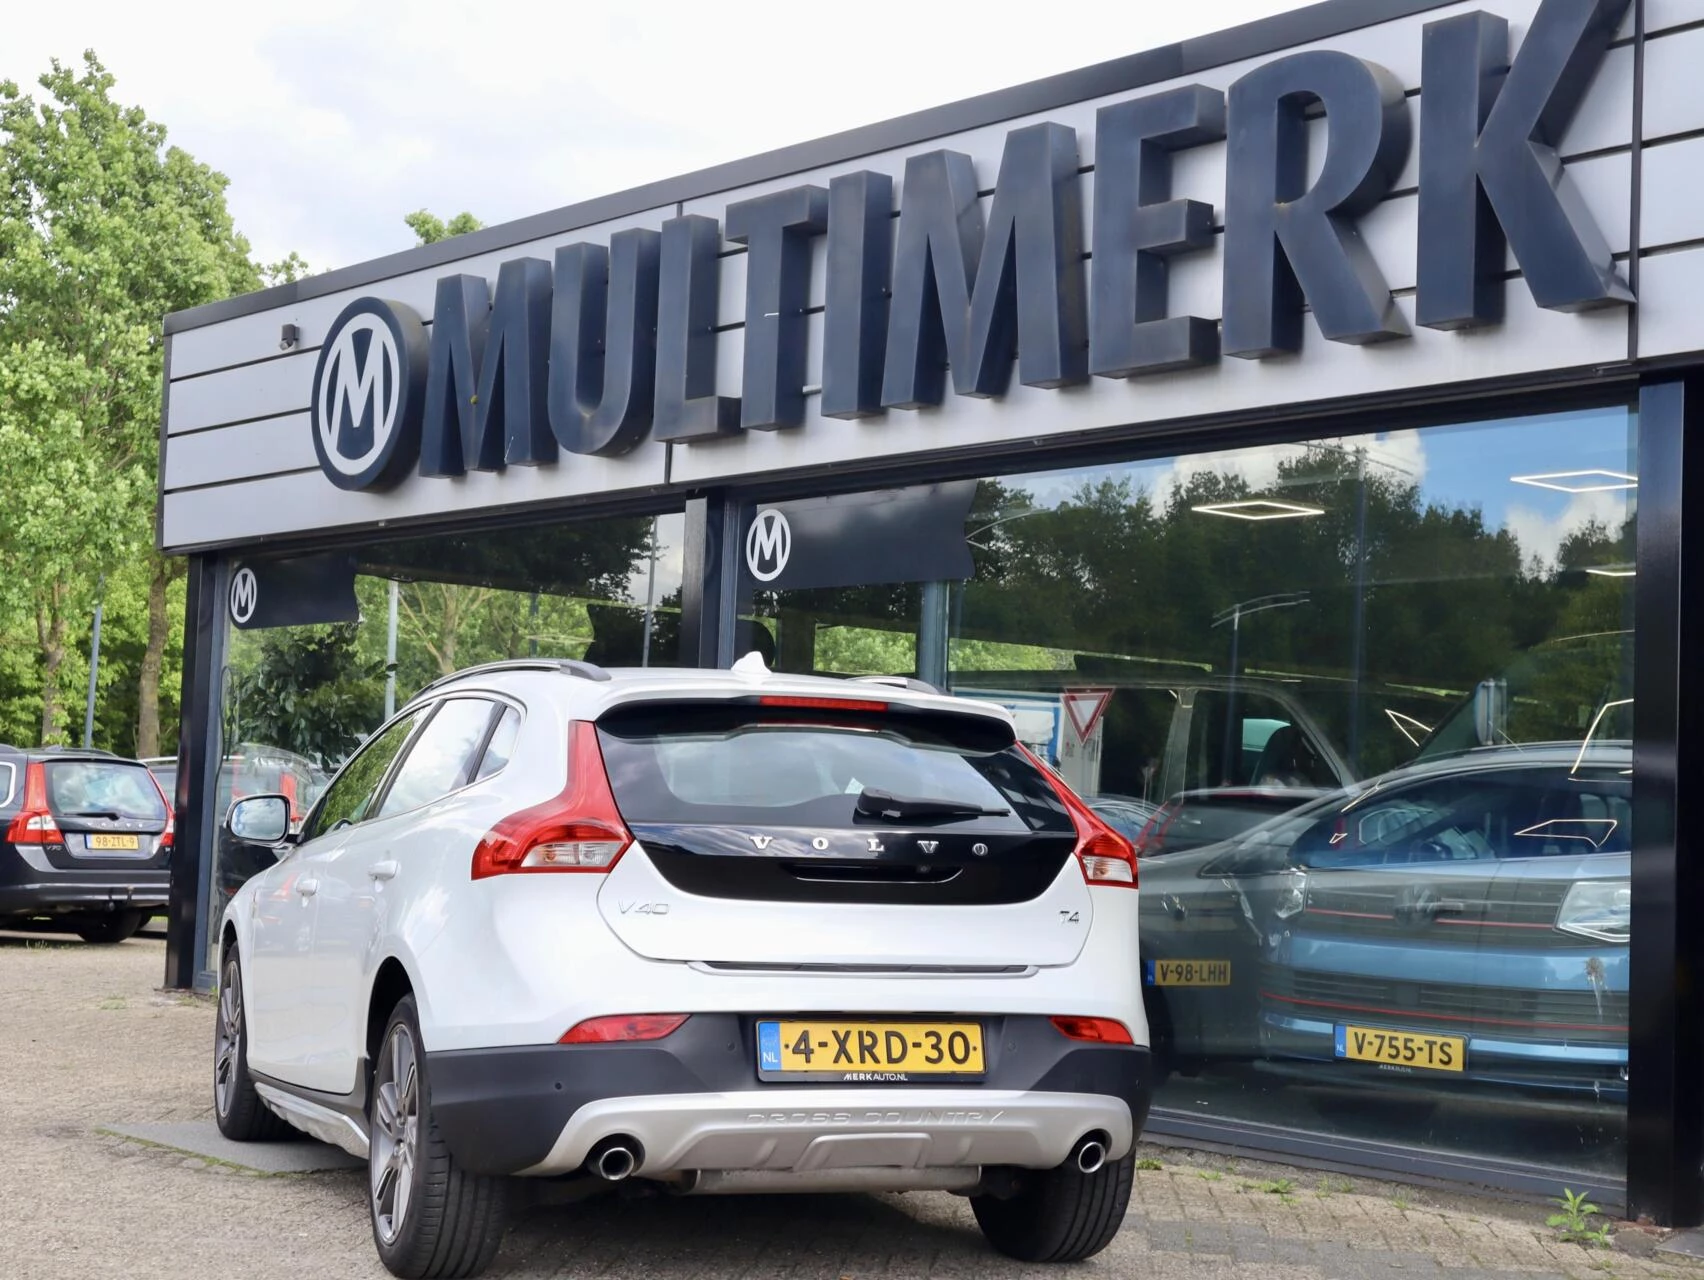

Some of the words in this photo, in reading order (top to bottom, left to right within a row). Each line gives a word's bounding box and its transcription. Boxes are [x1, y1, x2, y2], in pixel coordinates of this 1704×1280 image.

[419, 0, 1634, 478] MULTIMERK
[96, 836, 135, 847] 98-ZTL-9
[750, 836, 988, 856] VOLVO
[618, 899, 669, 915] V40
[1060, 910, 1079, 925] T4
[1160, 963, 1227, 982] V-98-LHH
[792, 1030, 970, 1065] 4-XRD-30
[1354, 1032, 1453, 1065] V-755-TS
[763, 1051, 778, 1063] NL
[747, 1112, 851, 1126] CROSS
[864, 1110, 1004, 1125] COUNTRY
